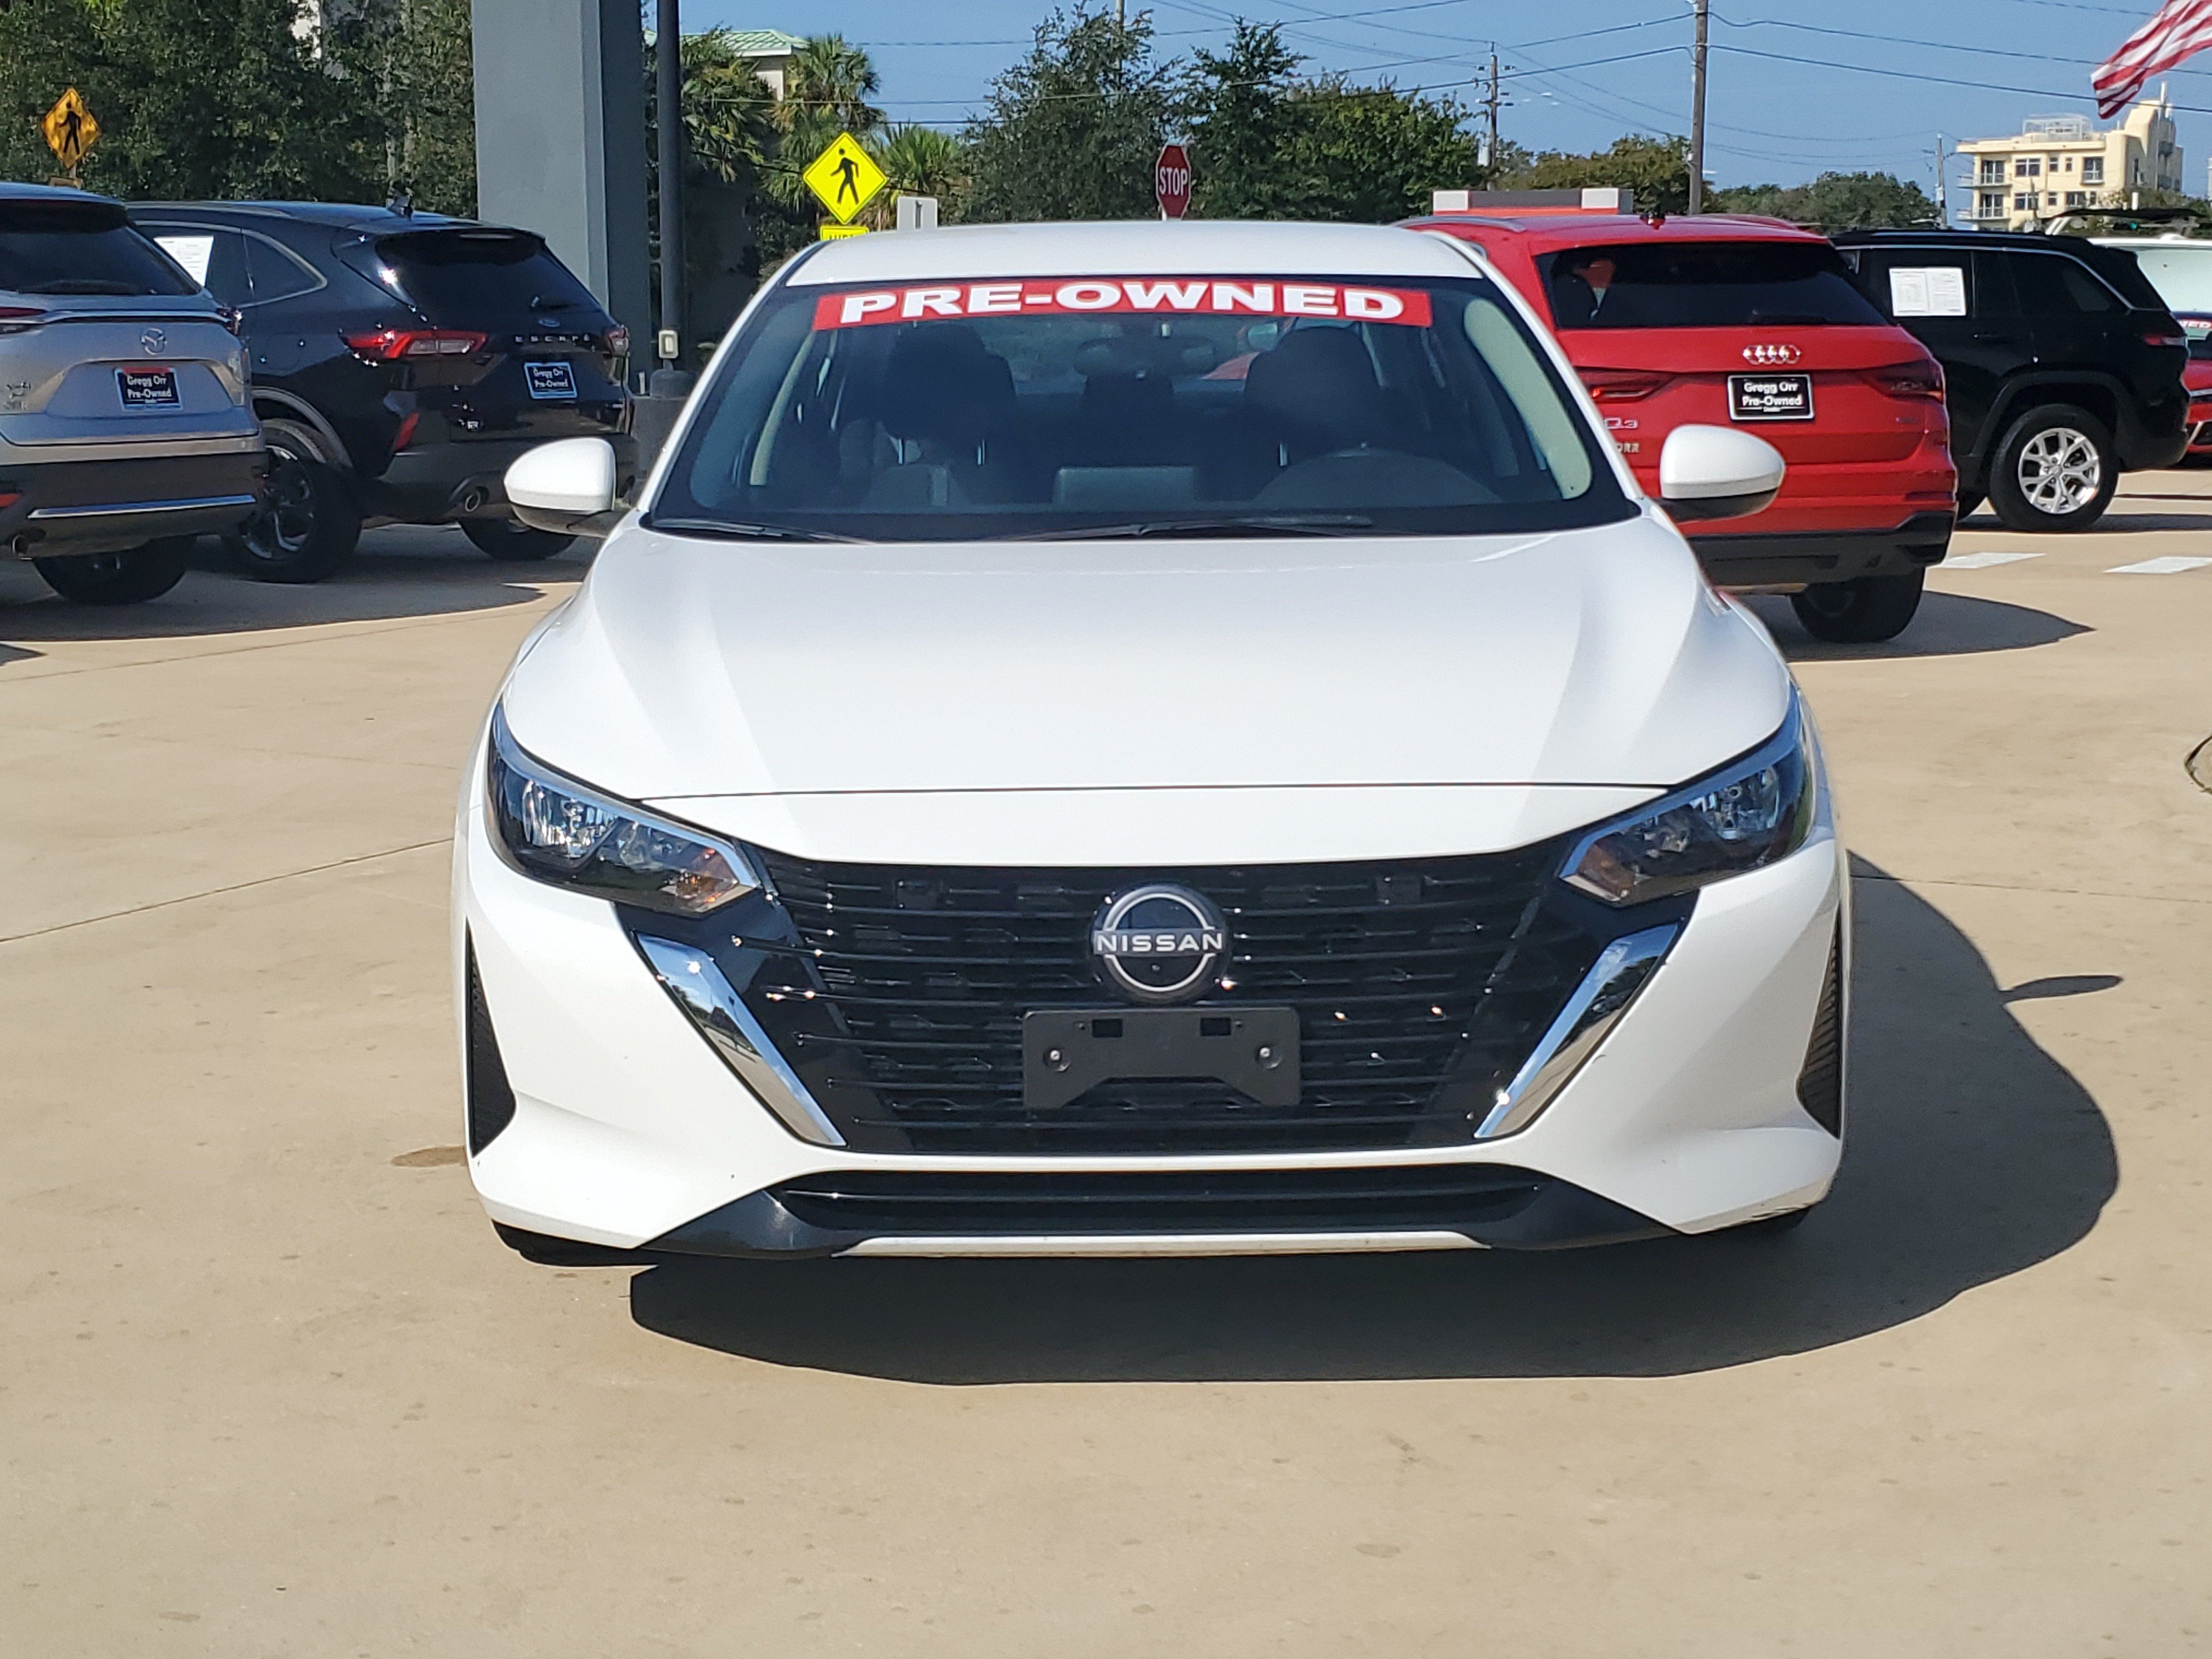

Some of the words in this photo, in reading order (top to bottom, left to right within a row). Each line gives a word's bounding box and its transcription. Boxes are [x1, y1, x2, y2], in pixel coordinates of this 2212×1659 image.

[1159, 166, 1188, 196] STOP
[840, 280, 1404, 324] PRE-OWNED
[127, 374, 153, 387] Gregg
[153, 375, 167, 385] Orr
[127, 387, 172, 399] Pre-Owned
[1743, 382, 1778, 394] Gregg
[1779, 381, 1799, 392] Orr
[1742, 393, 1803, 407] Pre-Owned
[1604, 417, 1638, 430] Q3
[1097, 933, 1222, 952] NISSAN
